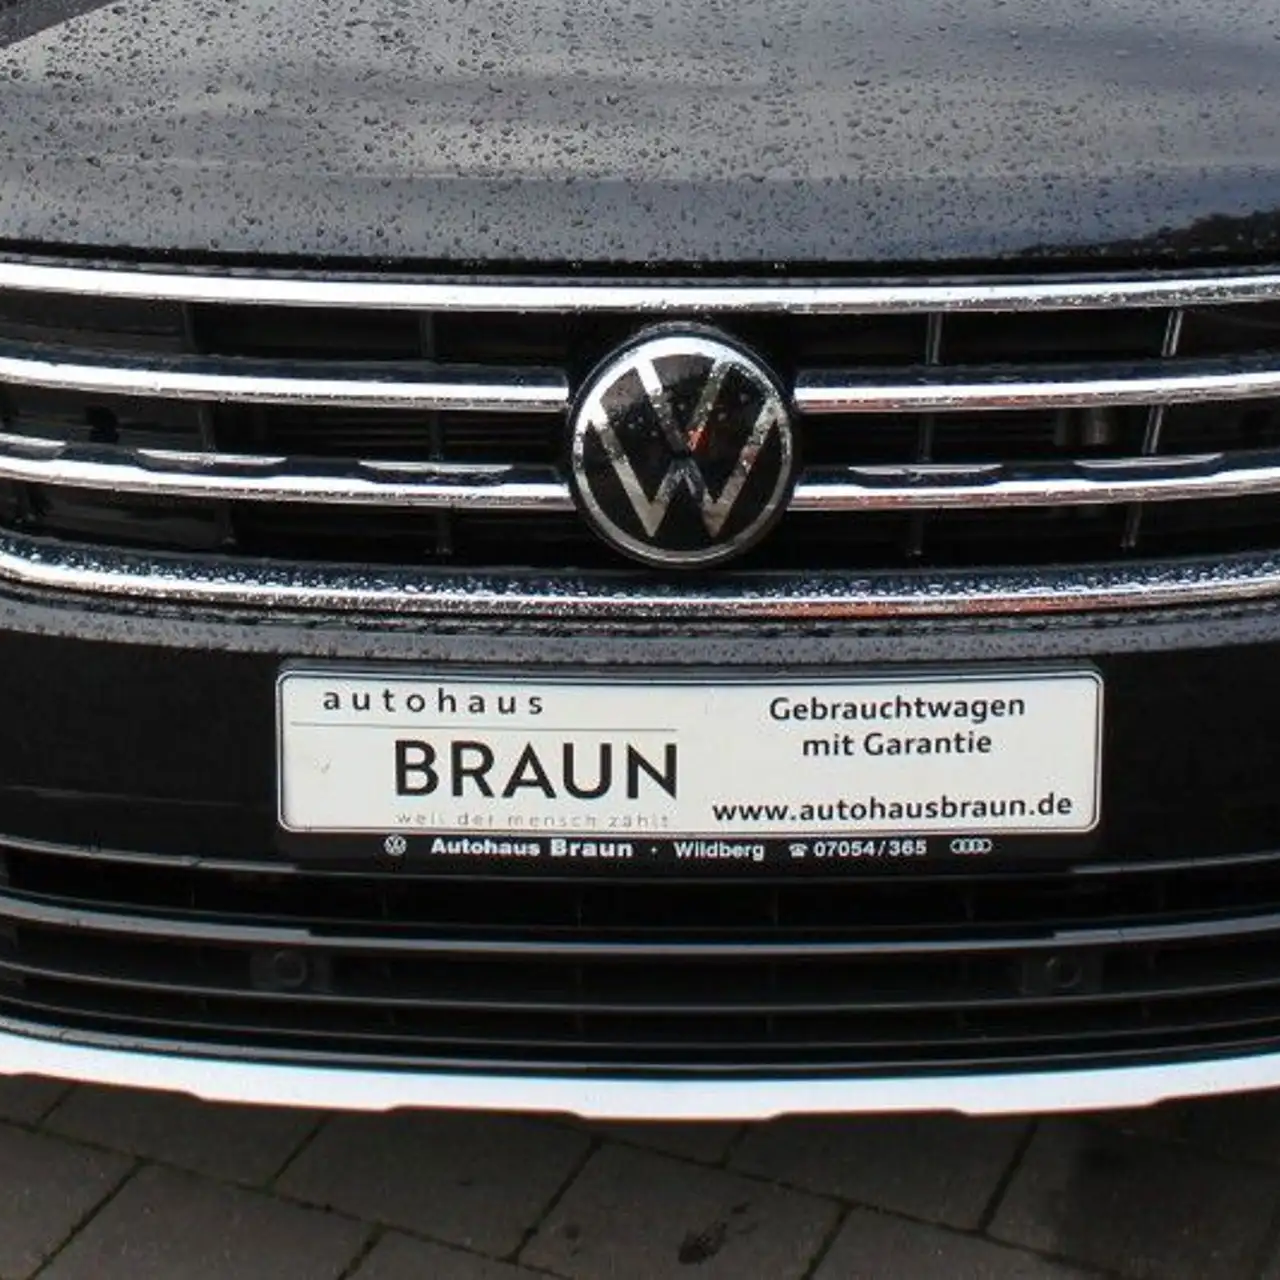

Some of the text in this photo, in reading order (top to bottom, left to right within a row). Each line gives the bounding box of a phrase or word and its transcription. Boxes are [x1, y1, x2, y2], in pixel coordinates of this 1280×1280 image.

[573, 332, 793, 564] VW
[323, 687, 544, 715] autohaus
[769, 695, 1026, 724] Gebrauchtwagen
[802, 731, 993, 757] mit Garantie
[394, 739, 678, 800] BRAUN
[457, 812, 494, 827] der
[507, 813, 596, 828] mensch
[712, 793, 1073, 821] www.autohausbraun.de
[430, 838, 541, 857] Autohaus
[550, 838, 634, 858] Braun
[673, 839, 765, 862] Wildberg
[814, 839, 928, 858] 07054/365
